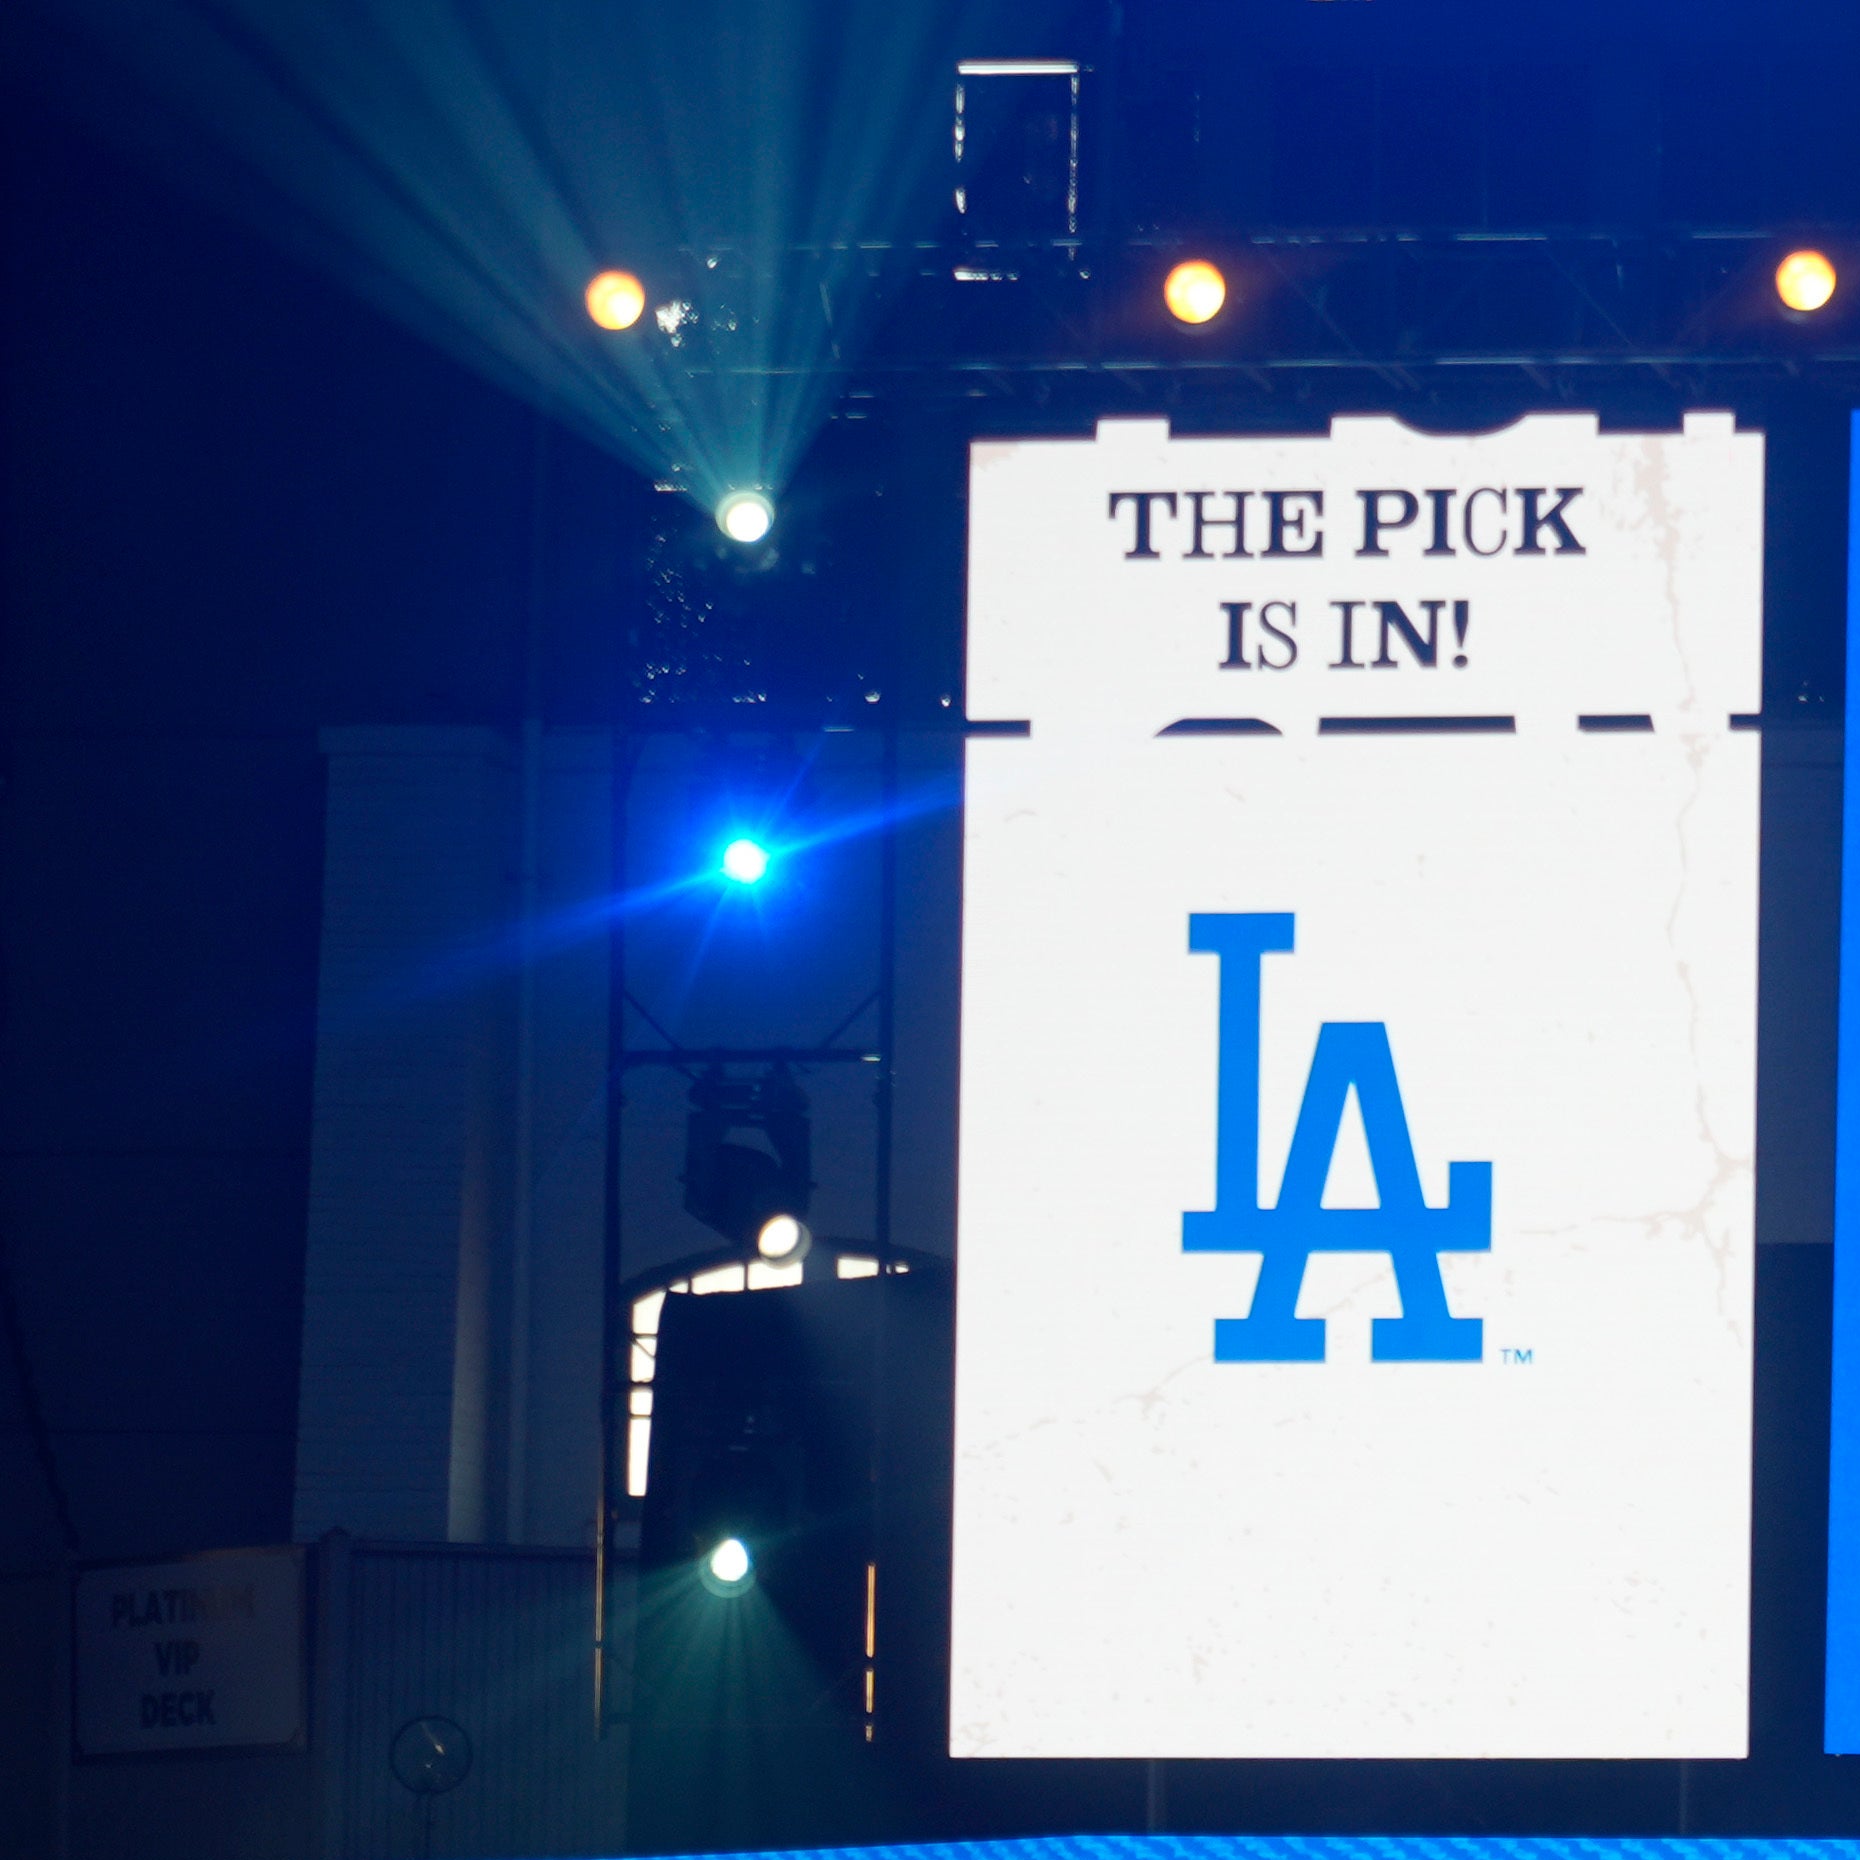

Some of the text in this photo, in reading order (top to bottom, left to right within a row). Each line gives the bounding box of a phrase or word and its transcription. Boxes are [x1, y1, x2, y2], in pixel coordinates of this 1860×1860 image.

[1109, 488, 1585, 558] THE PICK
[1220, 601, 1468, 669] IS IN!
[1182, 912, 1492, 1363] LA
[140, 1689, 216, 1729] DECK
